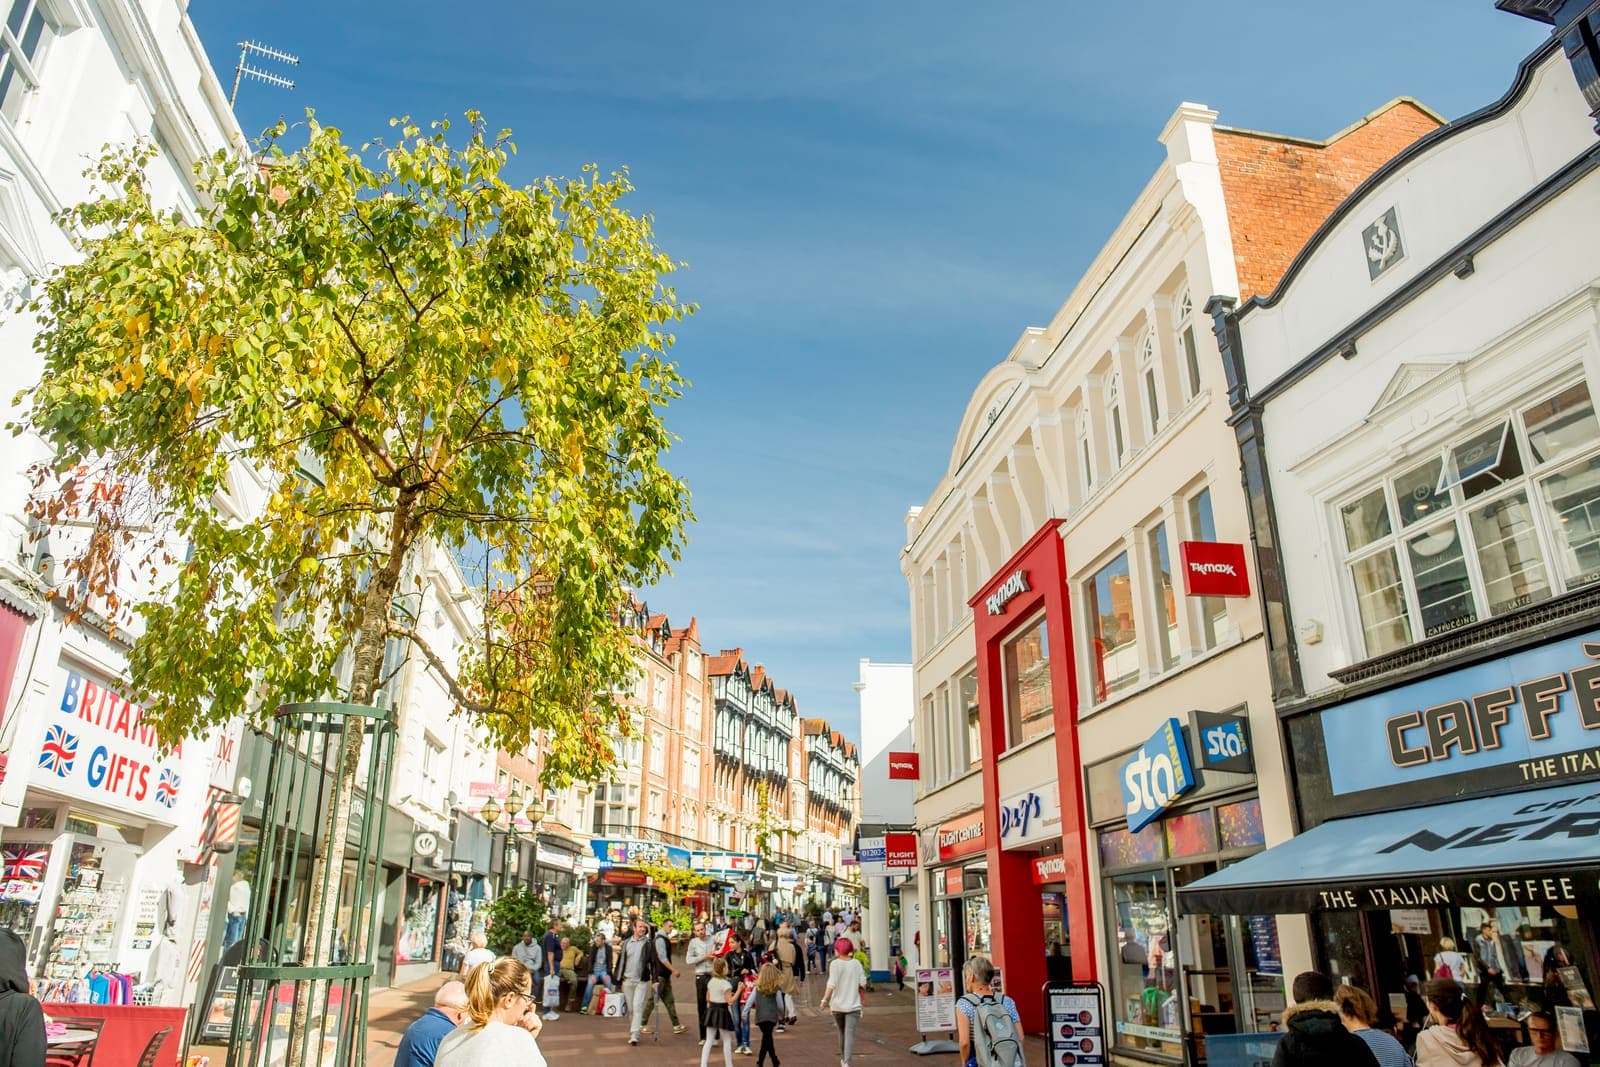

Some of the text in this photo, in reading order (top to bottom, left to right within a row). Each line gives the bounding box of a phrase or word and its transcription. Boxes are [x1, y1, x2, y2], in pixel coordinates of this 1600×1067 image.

[60, 670, 183, 761] BRITANA
[1206, 726, 1242, 758] sta
[87, 745, 151, 802] GIFTS
[1125, 721, 1185, 815] sta TRAVEL
[1519, 758, 1558, 781] THE
[888, 859, 917, 867] CENTRE
[889, 851, 915, 859] FLIGHT
[1320, 891, 1358, 909] THE
[1368, 884, 1450, 906] ITALIAN
[1468, 877, 1576, 904] COFFEE
